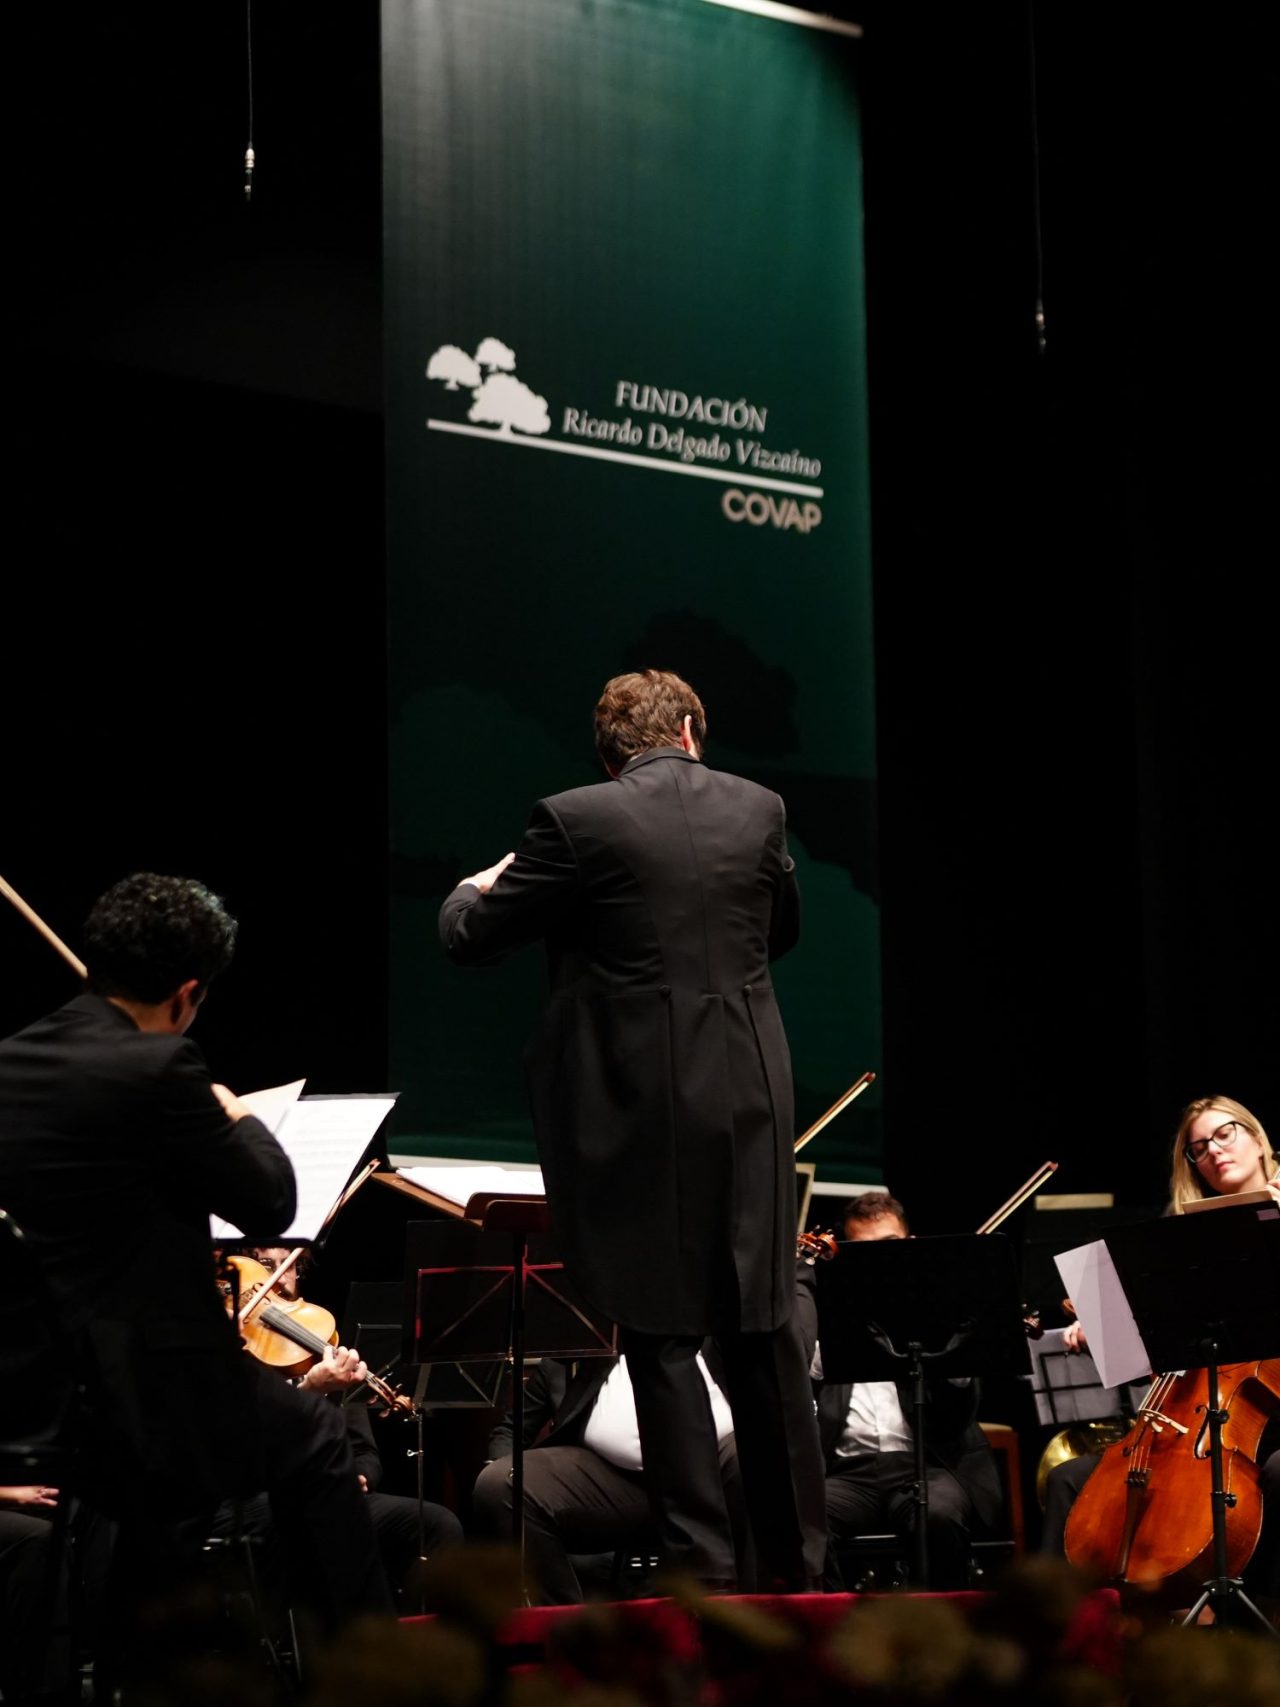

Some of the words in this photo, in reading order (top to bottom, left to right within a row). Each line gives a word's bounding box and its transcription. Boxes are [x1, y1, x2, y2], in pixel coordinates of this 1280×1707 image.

[615, 380, 768, 433] FUNDACIÓN
[562, 407, 643, 446] Ricardo
[647, 422, 731, 463] Delgado
[735, 438, 822, 478] Vizcaíno
[721, 488, 822, 533] COVAP
